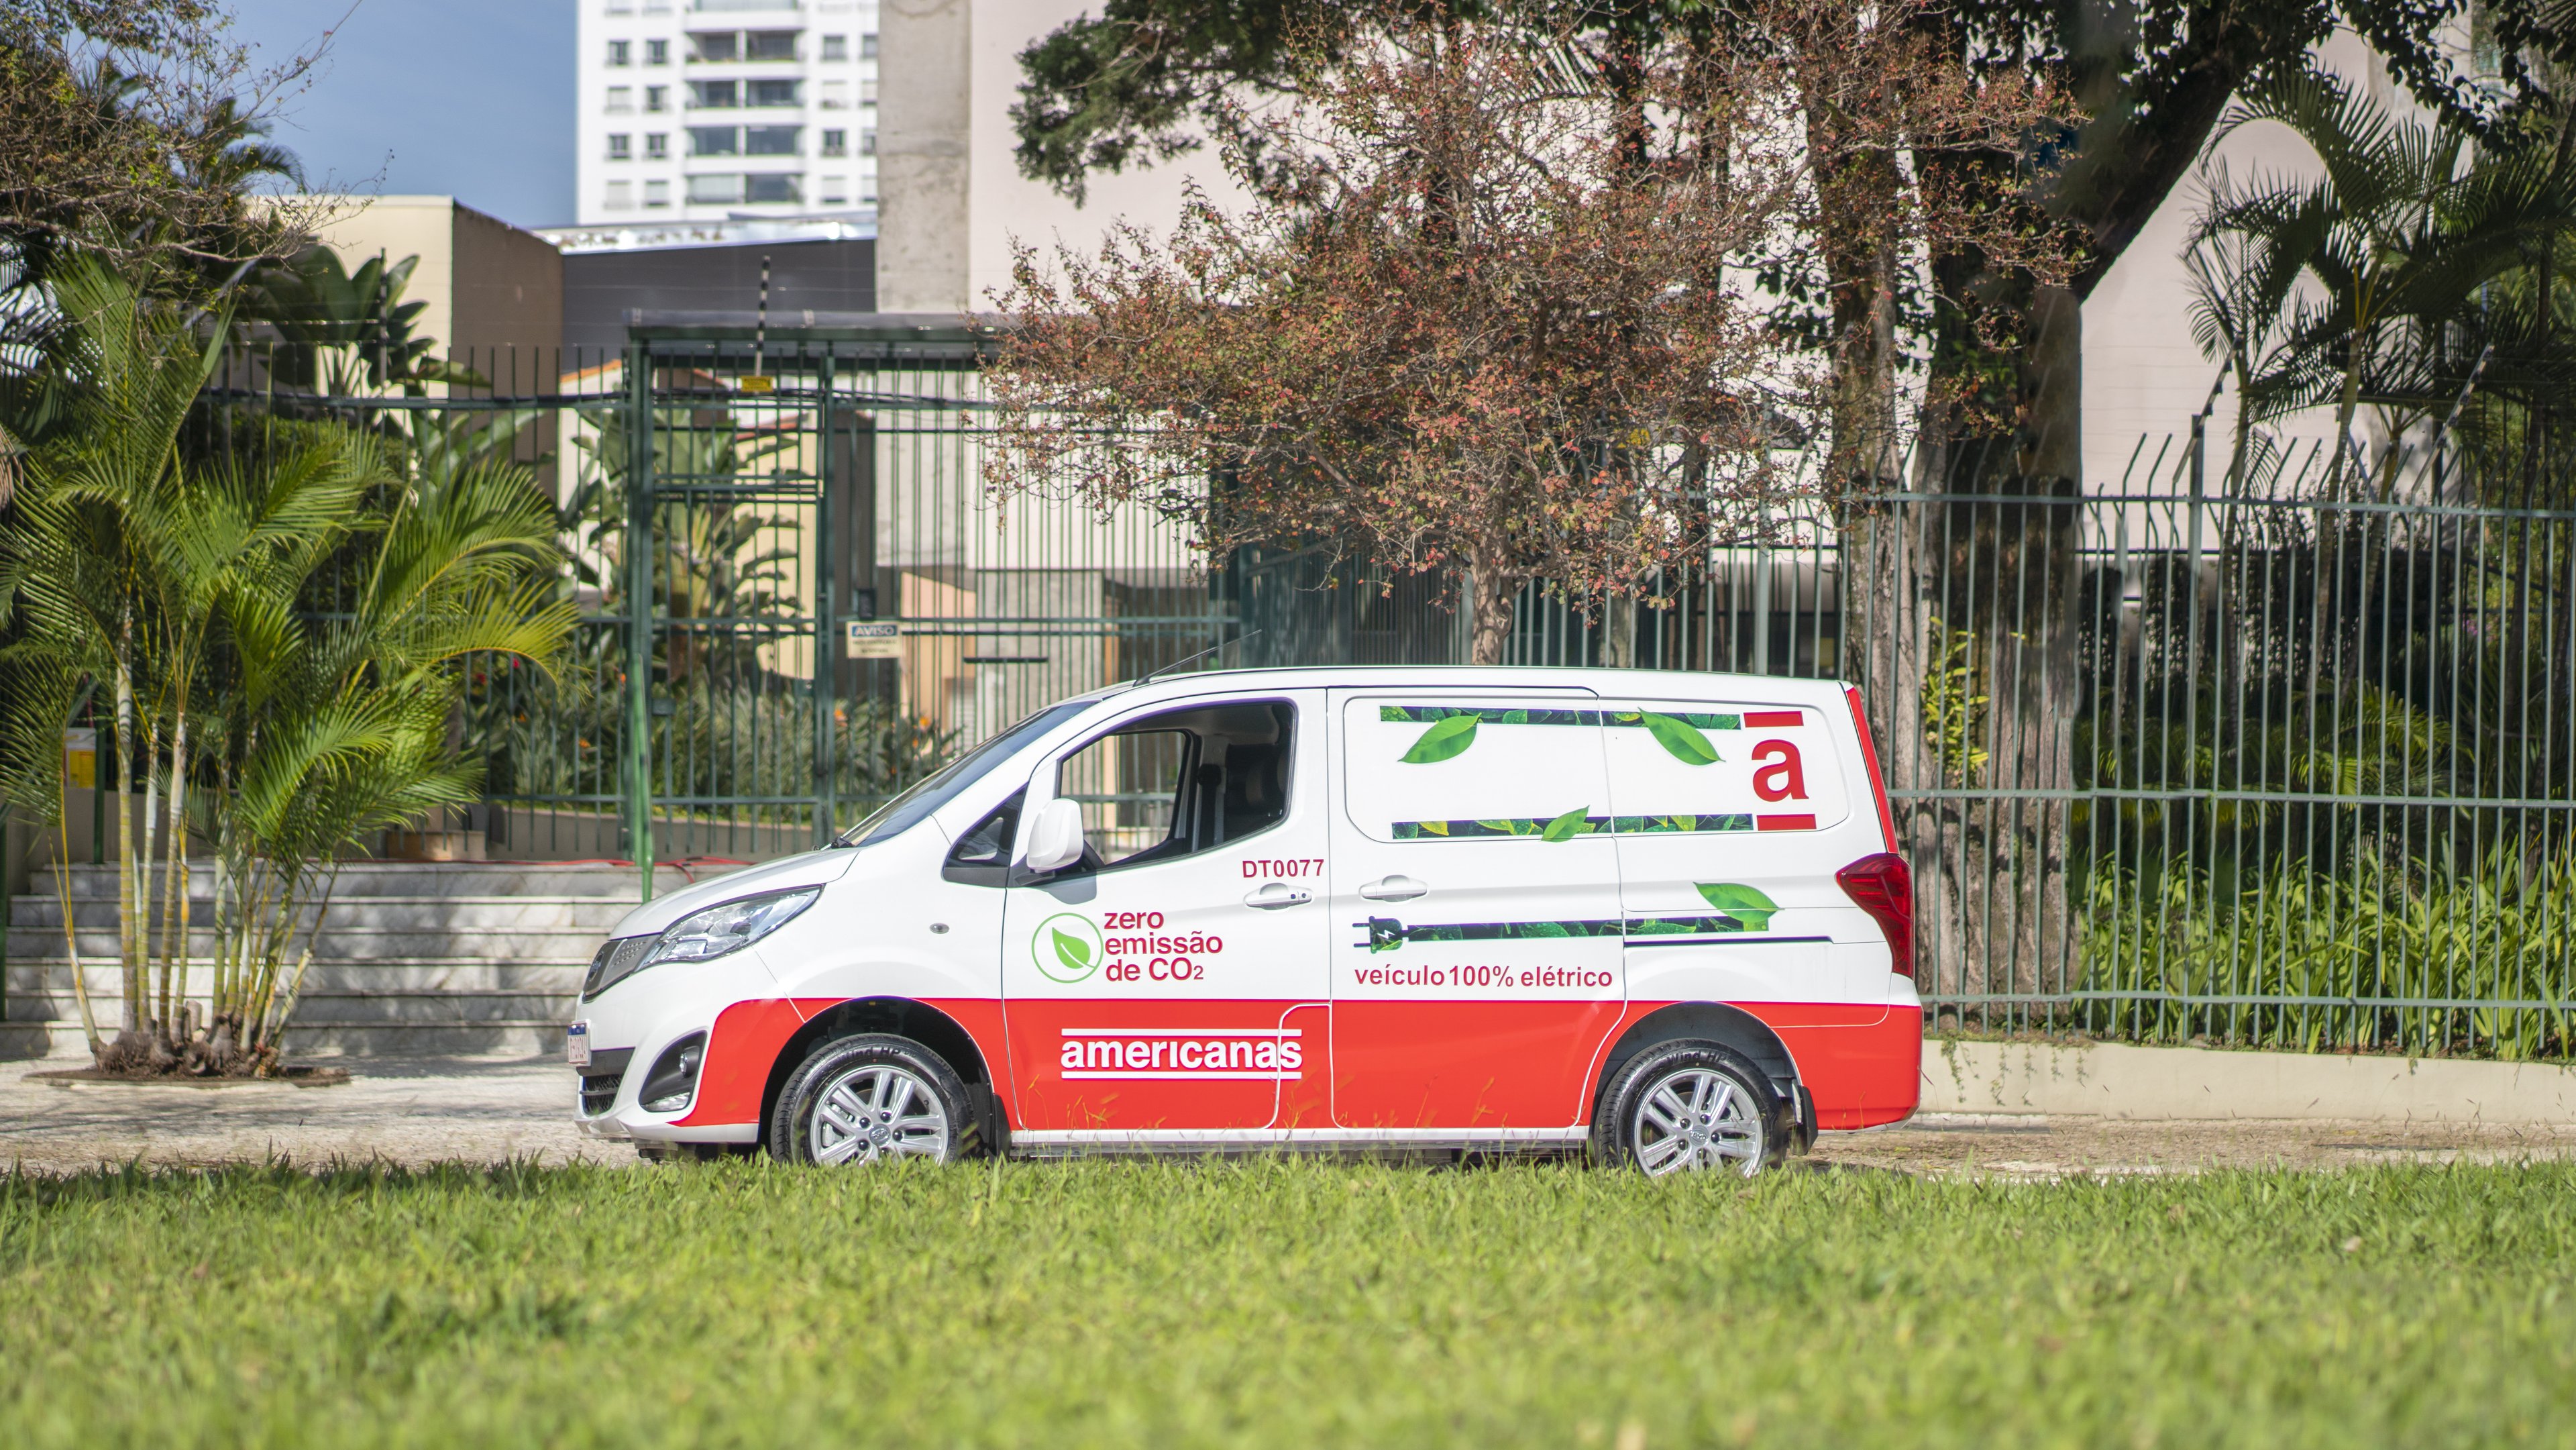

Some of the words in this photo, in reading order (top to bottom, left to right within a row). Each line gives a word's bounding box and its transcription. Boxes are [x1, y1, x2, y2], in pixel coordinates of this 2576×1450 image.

[855, 627, 894, 635] AVISO
[1751, 739, 1809, 802] a
[1242, 859, 1324, 878] DT0077
[1104, 911, 1165, 930] zero
[1104, 930, 1224, 955] emissão
[1105, 958, 1141, 982] de
[1354, 964, 1445, 986] veículo
[1449, 965, 1514, 986] 100%
[1520, 966, 1613, 987] elétrico
[1061, 1041, 1303, 1068] americanas
